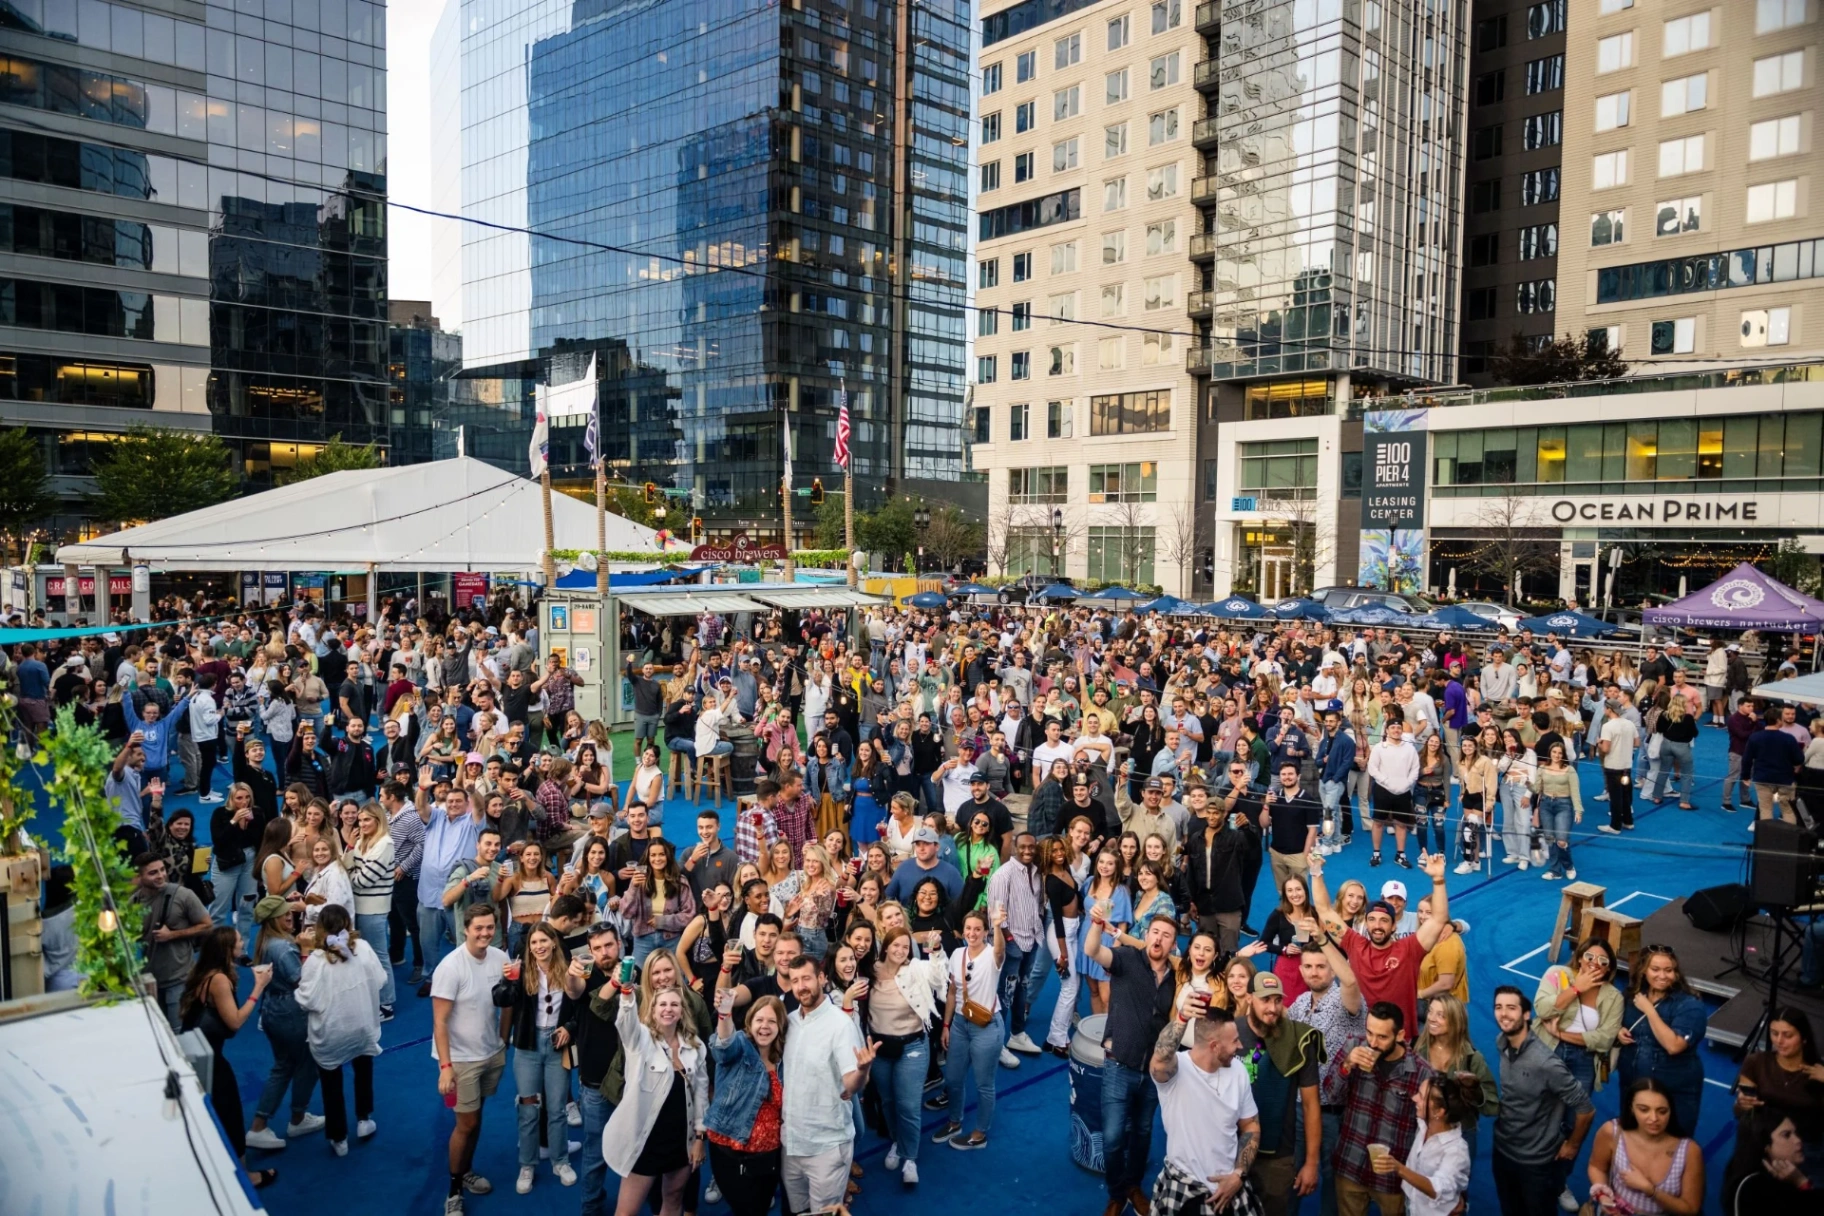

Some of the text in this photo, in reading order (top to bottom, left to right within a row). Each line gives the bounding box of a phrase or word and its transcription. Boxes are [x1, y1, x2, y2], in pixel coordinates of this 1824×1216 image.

[1375, 464, 1409, 482] PIER 4
[1368, 496, 1416, 507] LEASING
[1551, 499, 1758, 523] OCEAN PRIME
[700, 548, 780, 560] cisco brewers
[47, 580, 65, 590] CRA
[1652, 613, 1808, 631] cisco brewers nantucket
